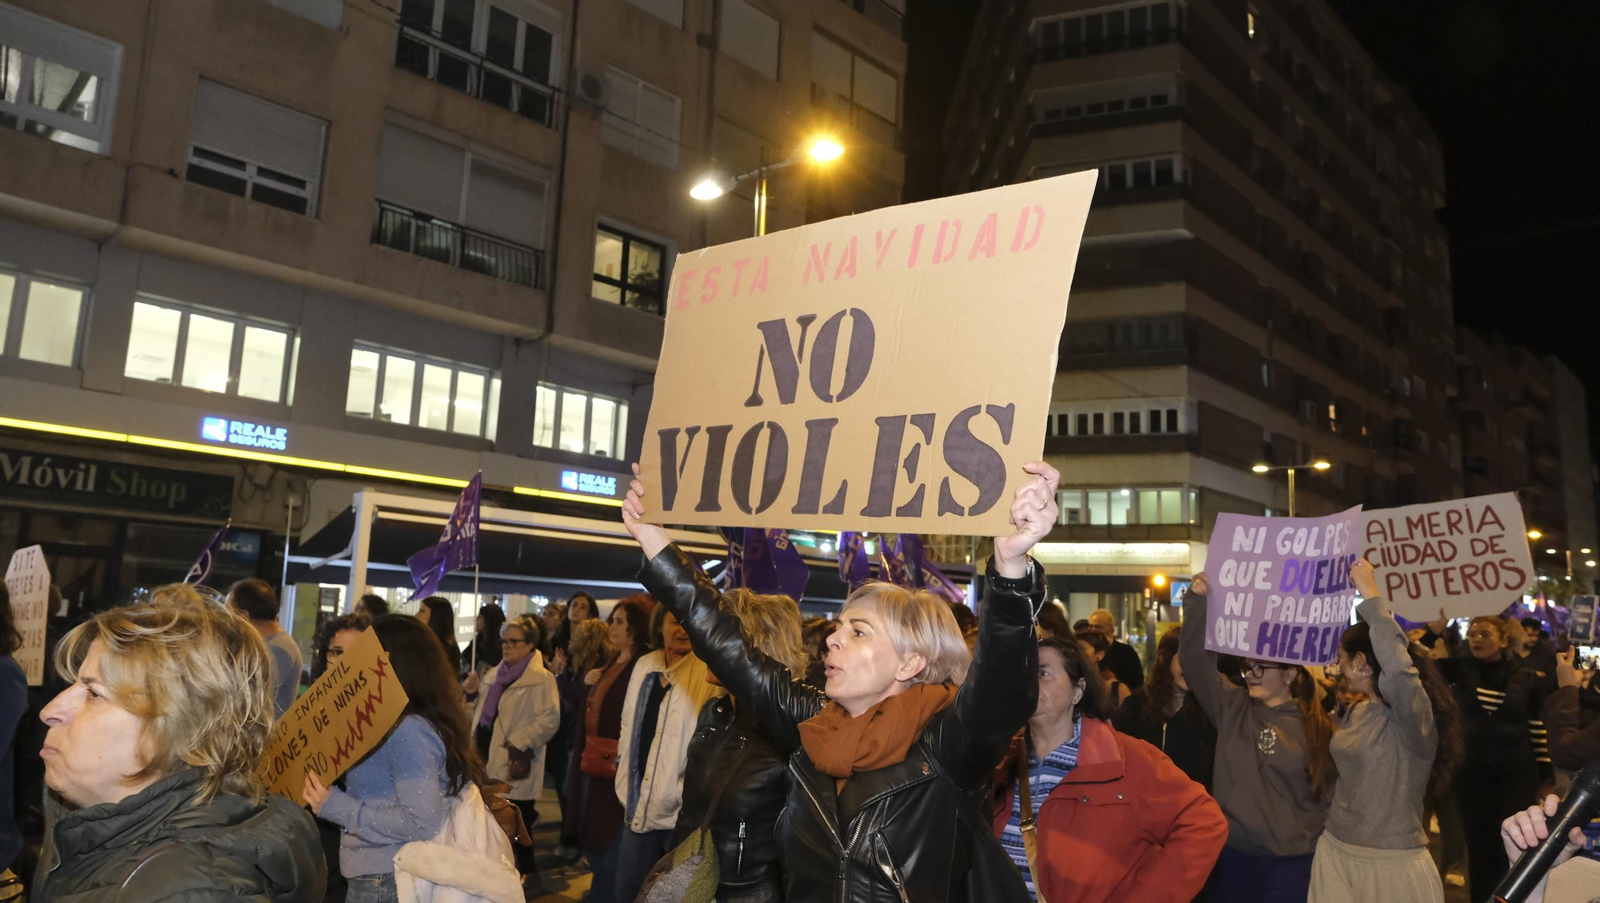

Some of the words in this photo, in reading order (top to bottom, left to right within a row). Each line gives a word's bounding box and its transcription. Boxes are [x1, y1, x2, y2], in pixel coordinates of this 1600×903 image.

[676, 255, 770, 310] ESTA
[802, 205, 1045, 287] NAVIDAD
[744, 307, 876, 407] NO
[229, 433, 286, 450] SEGUROS
[230, 421, 287, 441] REALE
[657, 403, 1016, 518] VIOLES
[0, 453, 97, 492] Móvil
[107, 467, 187, 508] Shop
[579, 473, 616, 488] REALE
[1232, 526, 1267, 554] NI
[1275, 519, 1351, 557] GOLPES
[1470, 534, 1507, 557] DE
[1218, 559, 1273, 590] QUE
[1385, 558, 1527, 602] PUTEROS
[1224, 591, 1254, 617] NI
[1264, 594, 1356, 624] PALABRAS
[1215, 616, 1250, 651] QUE
[294, 660, 351, 721] INFANTIL
[312, 708, 331, 733] DE
[333, 670, 368, 713] NIÑAS
